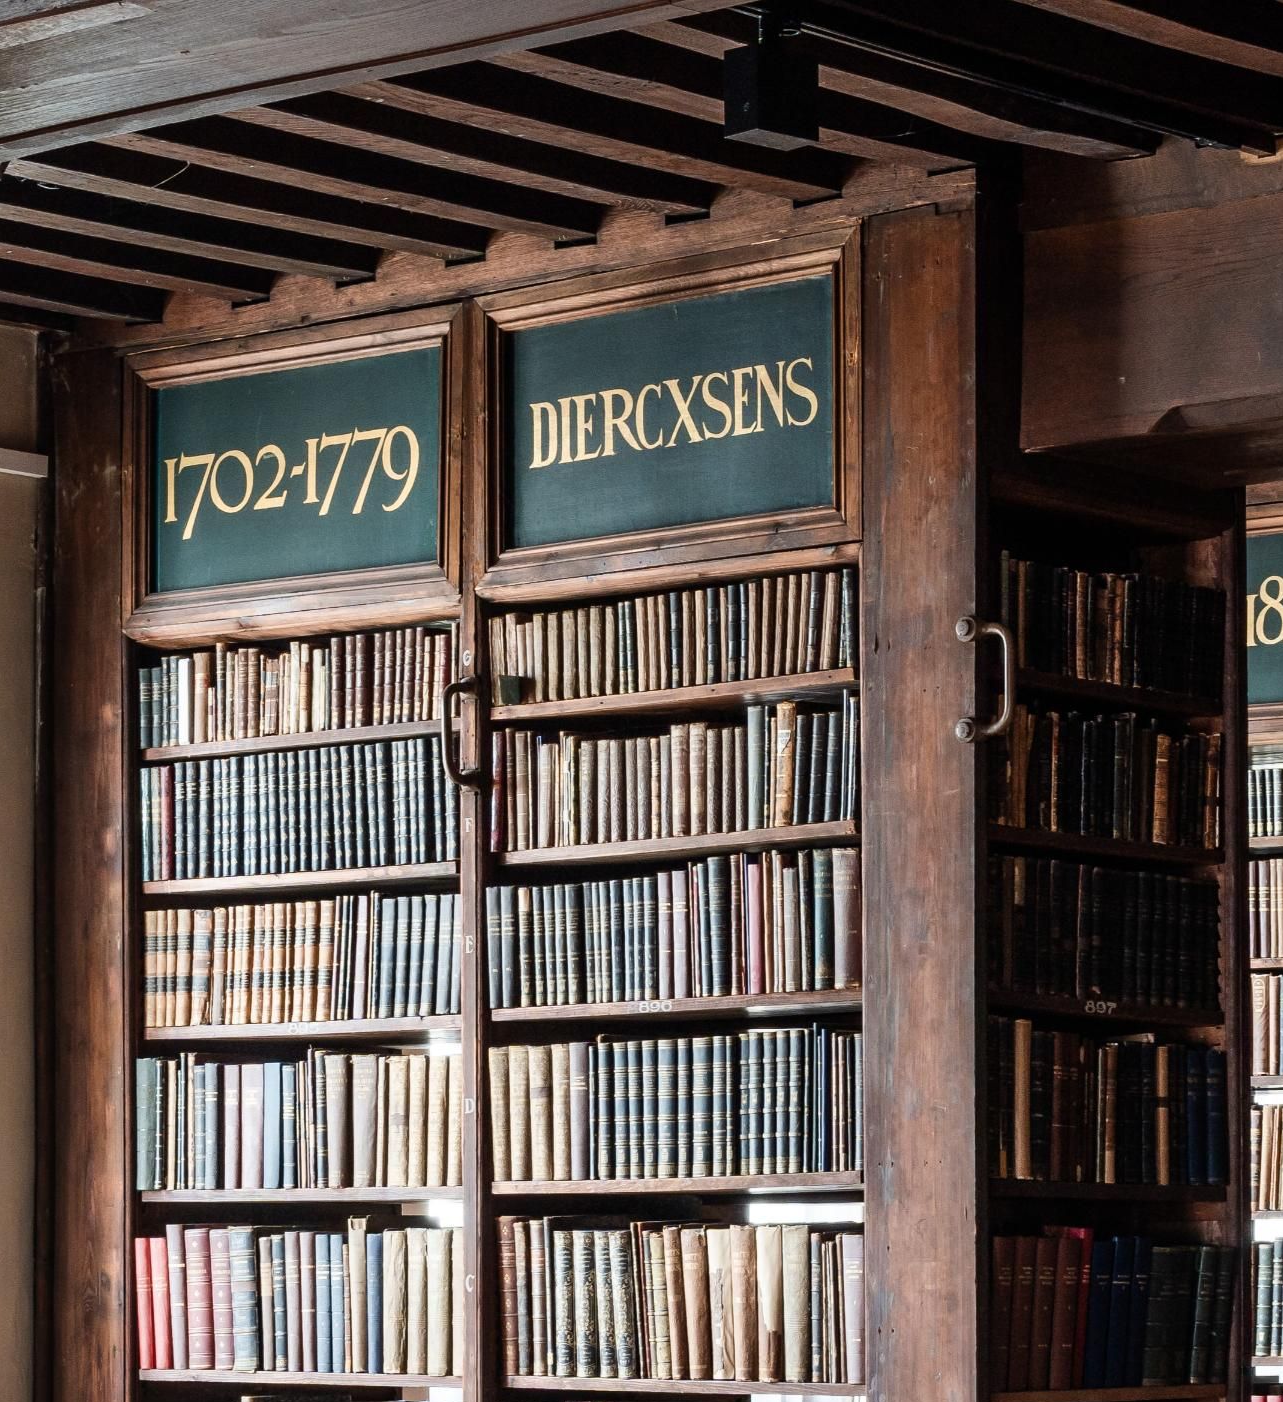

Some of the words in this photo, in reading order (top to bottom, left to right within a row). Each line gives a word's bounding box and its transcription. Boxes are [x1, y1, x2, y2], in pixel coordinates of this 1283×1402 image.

[529, 357, 819, 470] DIERCXSENS
[164, 424, 420, 541] 1702-1779
[1085, 999, 1117, 1015] 897
